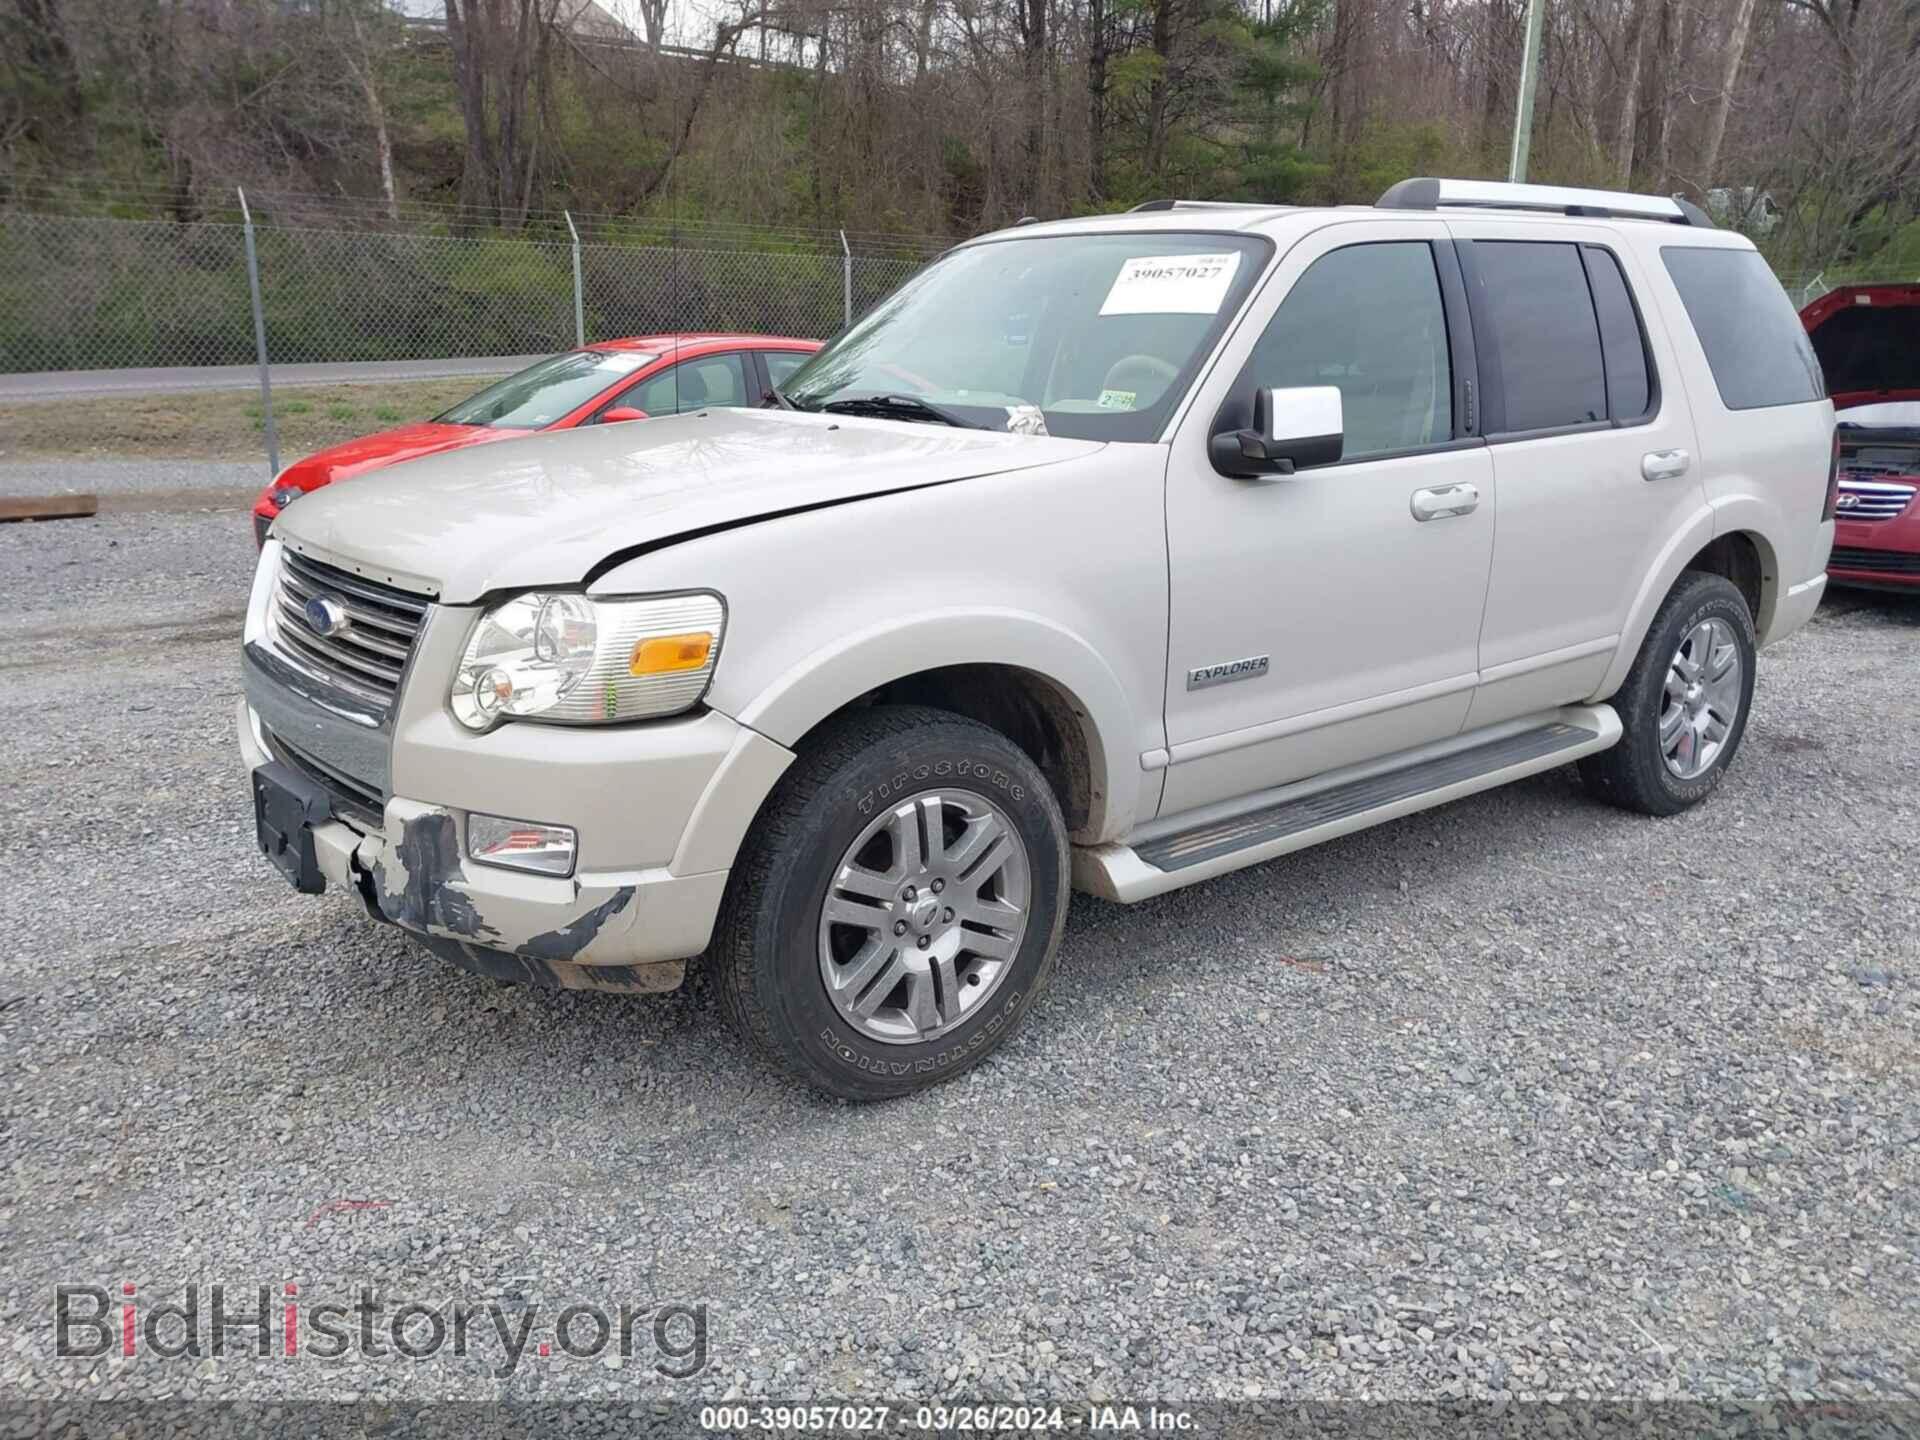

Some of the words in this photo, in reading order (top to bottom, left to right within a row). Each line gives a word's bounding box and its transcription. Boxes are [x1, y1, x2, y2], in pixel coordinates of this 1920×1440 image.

[1127, 266, 1223, 281] 39057027
[1193, 656, 1269, 682] EXPLORER
[819, 990, 1023, 1076] DESTINATION
